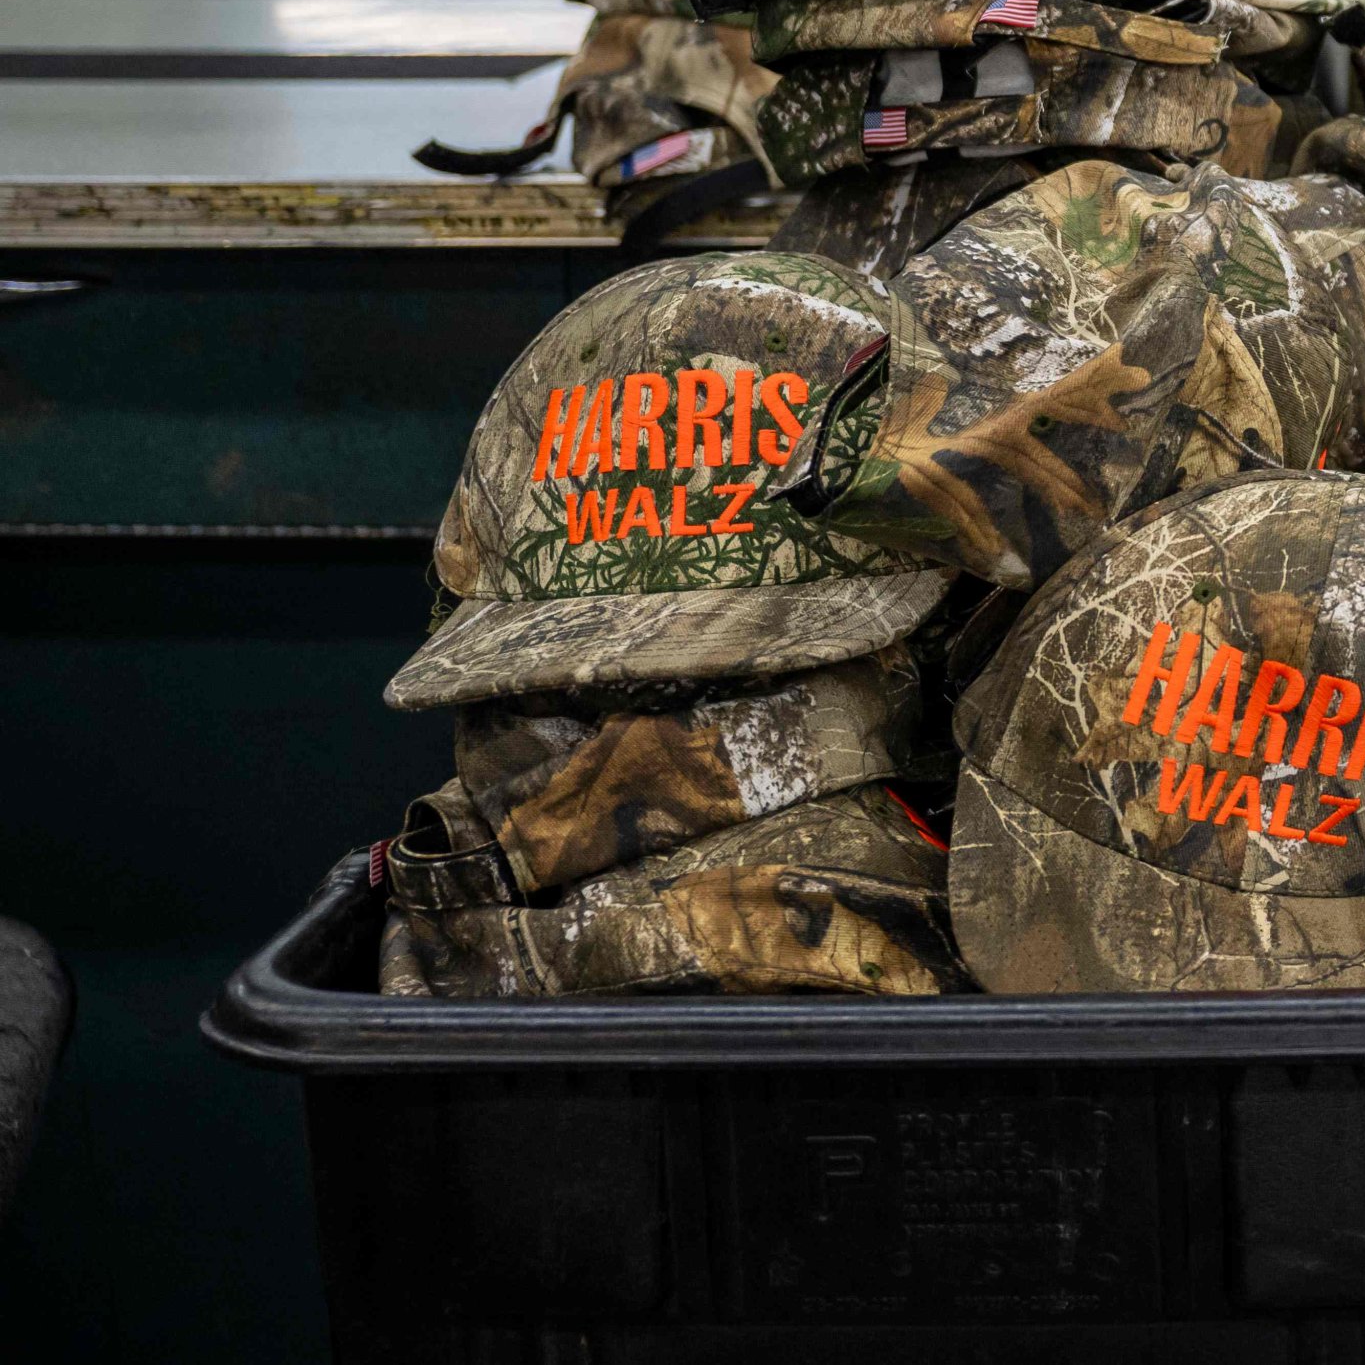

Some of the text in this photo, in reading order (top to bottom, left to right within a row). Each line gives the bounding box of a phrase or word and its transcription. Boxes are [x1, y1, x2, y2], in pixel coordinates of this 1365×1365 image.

[531, 369, 810, 481] HARRIS
[565, 483, 756, 544] WALZ
[1157, 758, 1361, 846] WALZ
